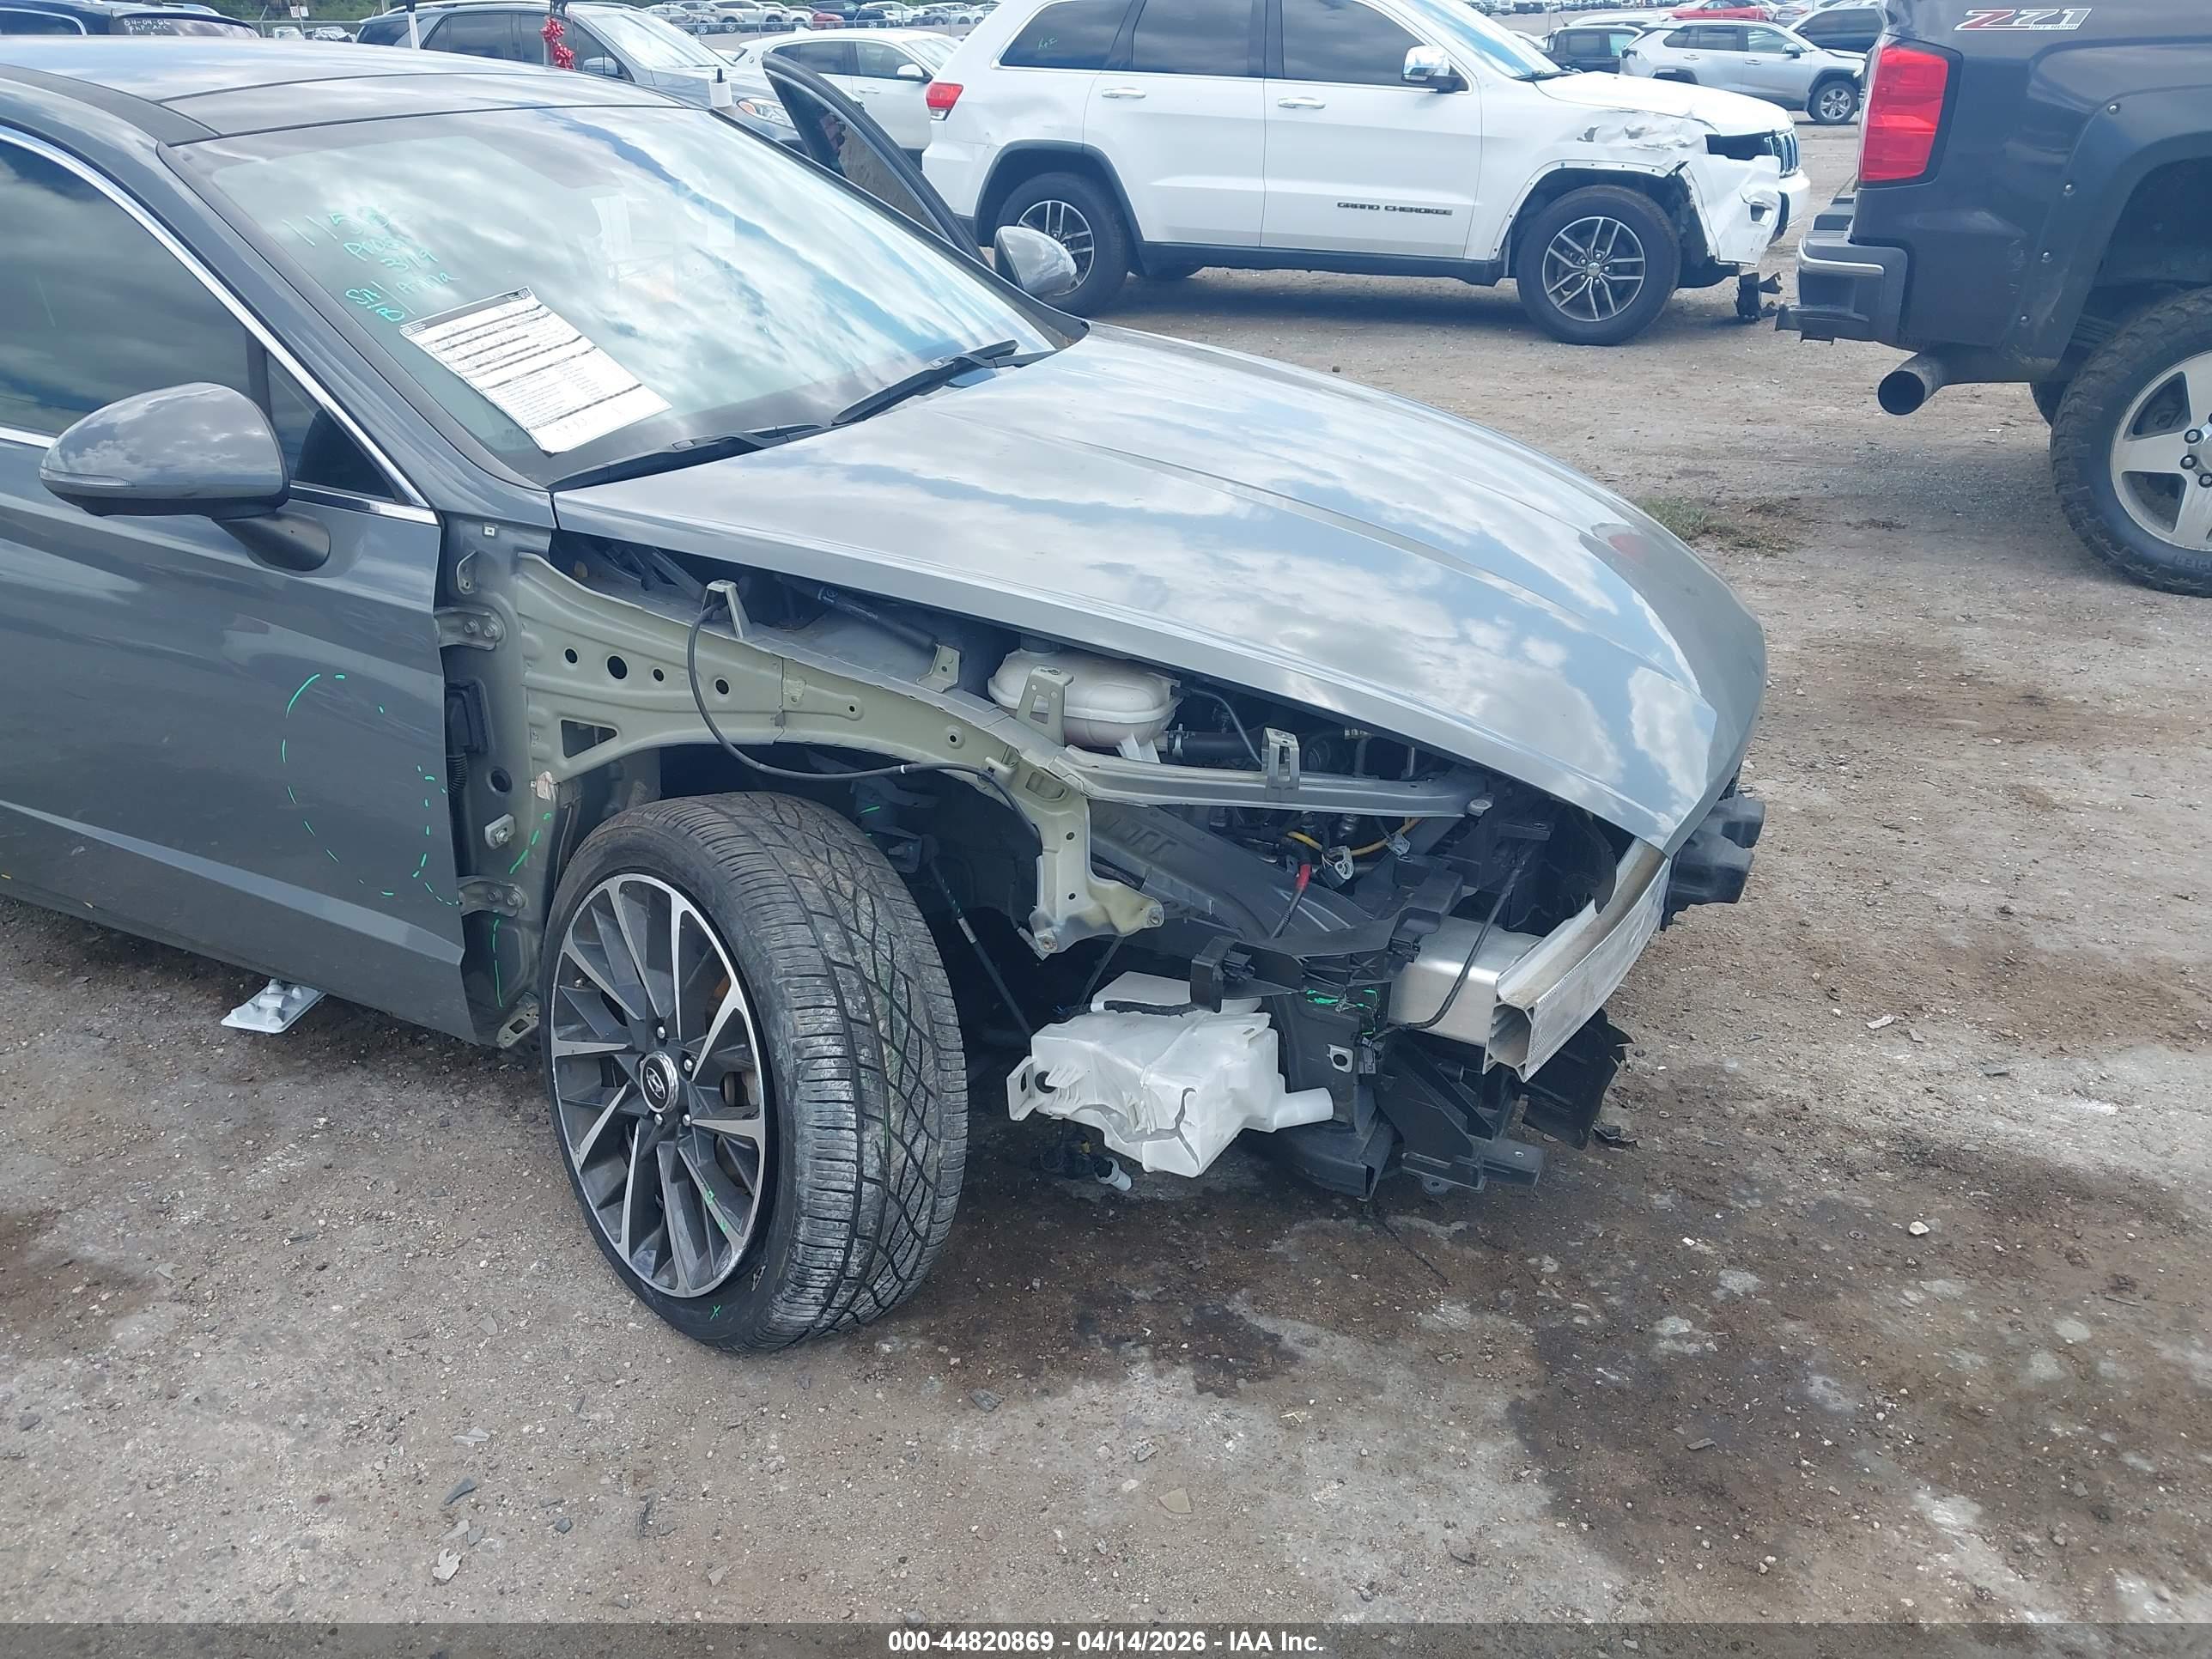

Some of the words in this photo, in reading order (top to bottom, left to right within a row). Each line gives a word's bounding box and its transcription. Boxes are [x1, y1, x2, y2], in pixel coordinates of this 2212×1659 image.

[1954, 7, 2094, 31] Z71
[1337, 202, 1380, 211] GRAND
[1384, 205, 1453, 216] CHEROKEE
